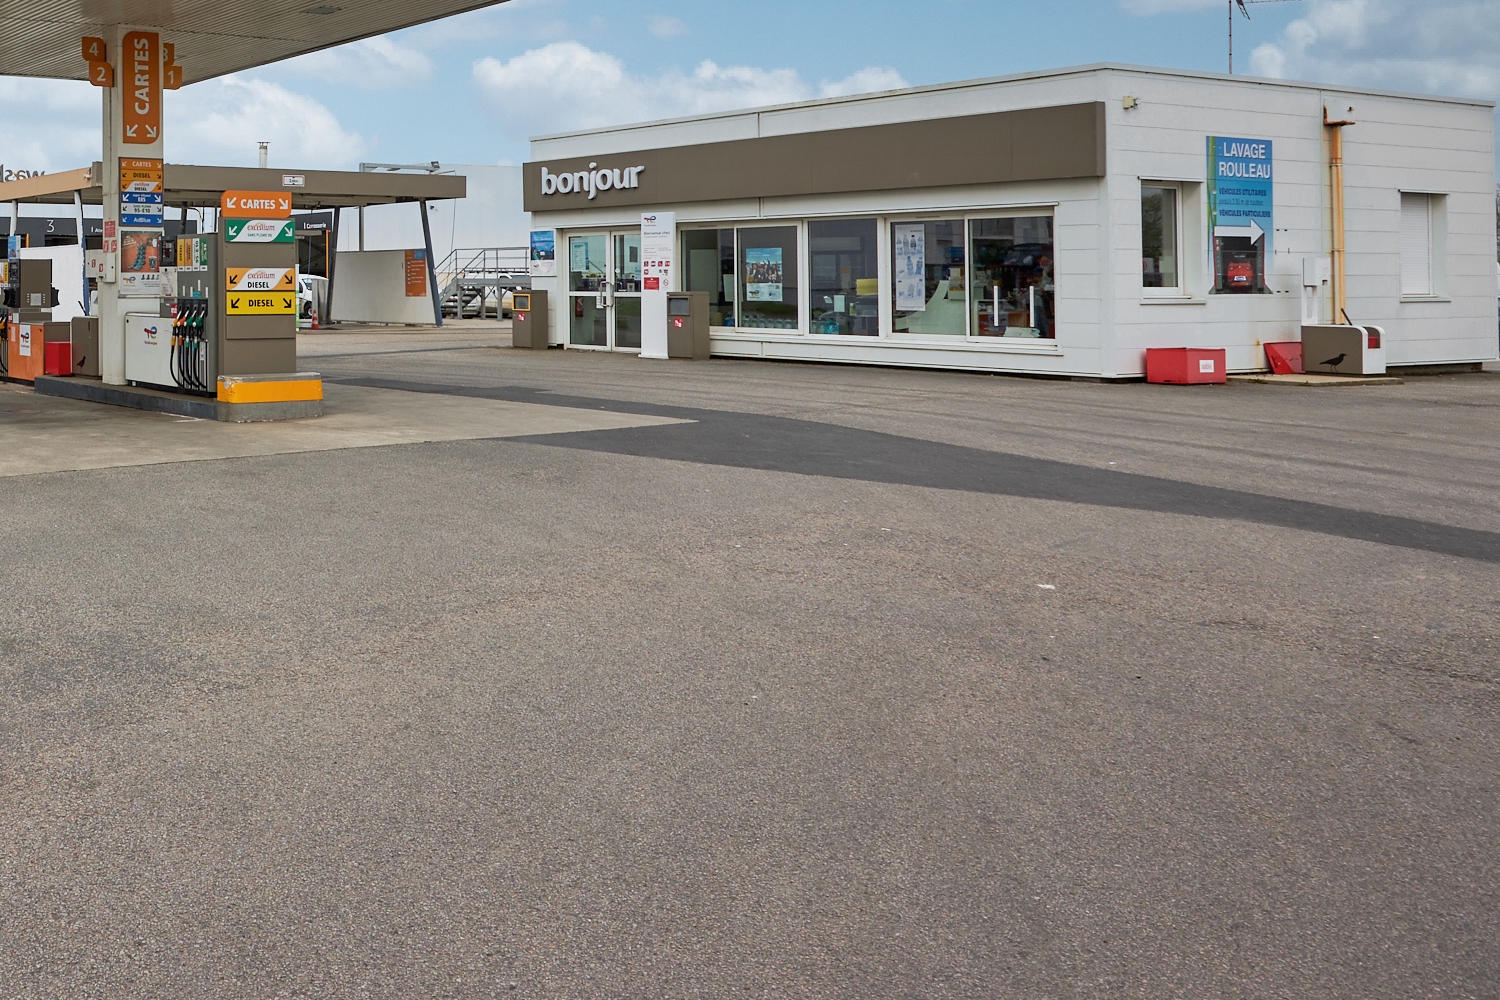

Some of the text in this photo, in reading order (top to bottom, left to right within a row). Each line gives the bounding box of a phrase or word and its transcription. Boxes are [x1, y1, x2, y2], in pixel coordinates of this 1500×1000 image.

[89, 42, 99, 56] 4
[96, 67, 106, 82] 2
[134, 38, 150, 114] CARTES
[167, 70, 174, 84] 1
[1223, 142, 1266, 159] LAVAGE
[1219, 162, 1270, 179] ROULEAU
[541, 162, 645, 199] bonjour
[240, 199, 276, 209] CARTES
[46, 219, 55, 232] 3
[247, 223, 275, 231] excellium
[247, 271, 275, 279] excellium
[248, 299, 274, 307] DIESEL
